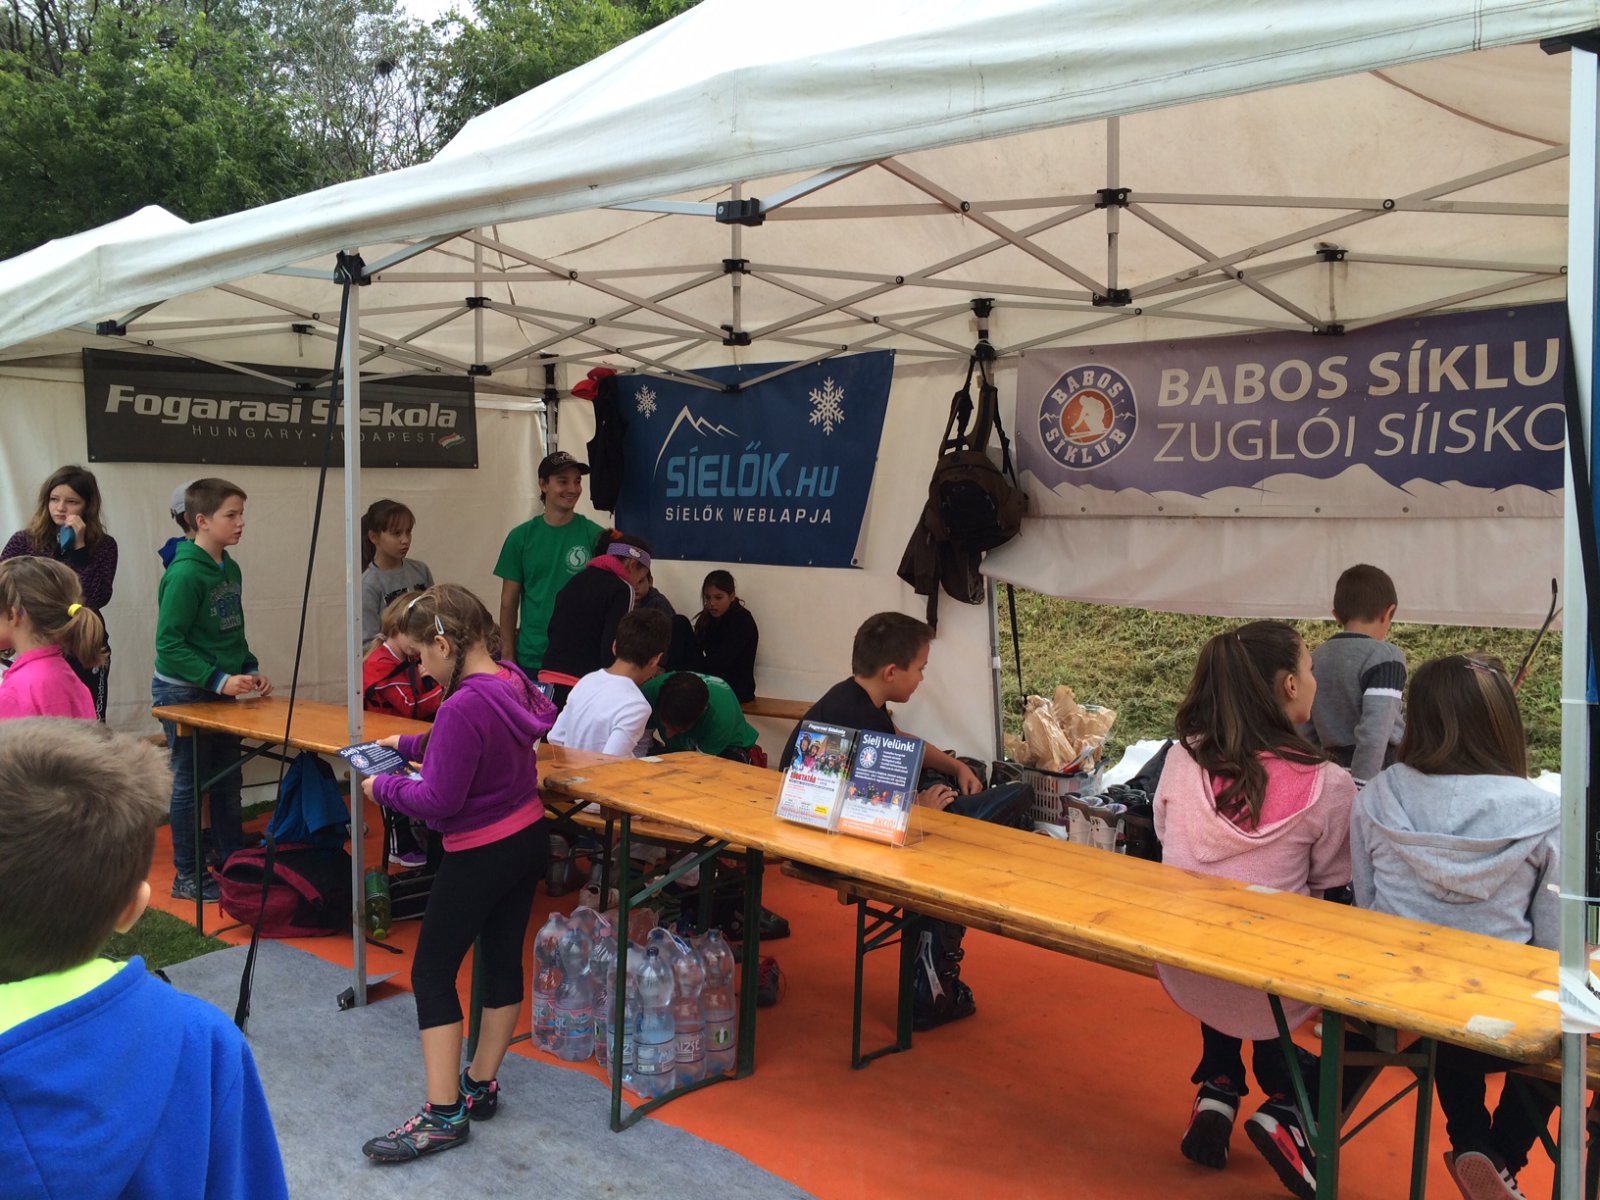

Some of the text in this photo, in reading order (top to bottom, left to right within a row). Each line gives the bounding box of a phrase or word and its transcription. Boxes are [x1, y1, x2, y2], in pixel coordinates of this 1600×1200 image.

[1051, 370, 1124, 405] BABOS
[1157, 355, 1348, 407] BABOS
[104, 383, 303, 425] Fogarasi
[192, 424, 304, 440] HUNGARY
[1153, 402, 1566, 463] ZUGLÓI SÍISKO
[666, 440, 840, 498] SÍELŐK.HU
[665, 505, 832, 524] SÍELŐK WEBLAPJA
[882, 737, 915, 753] Velünk!
